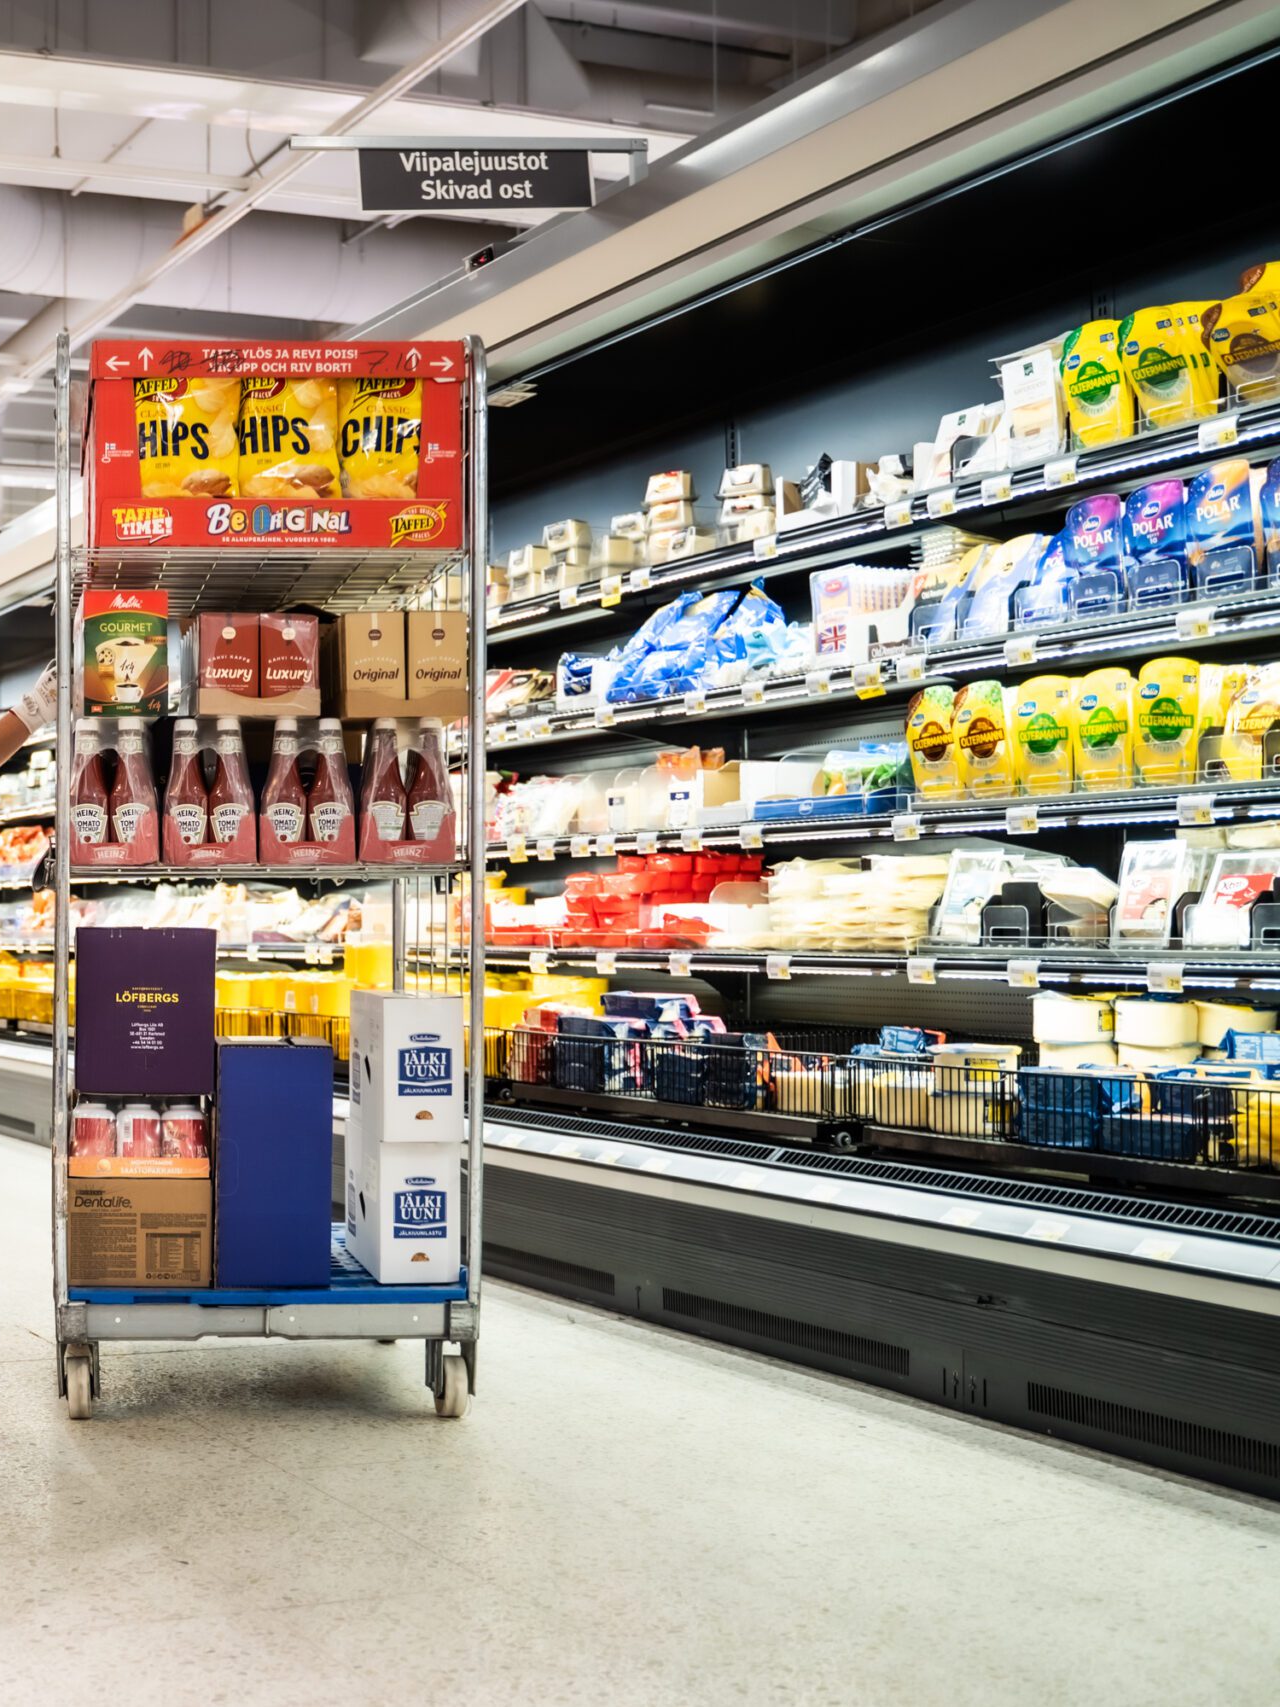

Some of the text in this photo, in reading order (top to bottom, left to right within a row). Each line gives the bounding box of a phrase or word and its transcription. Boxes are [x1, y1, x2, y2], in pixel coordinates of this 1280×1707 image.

[399, 151, 549, 177] Viipalejuustot
[421, 179, 534, 201] Skivad ost
[242, 347, 273, 359] YLÖS
[275, 349, 289, 359] JA
[293, 349, 321, 359] REVI
[325, 349, 358, 359] POIS!
[235, 362, 258, 373] UPP
[261, 362, 287, 373] OCH
[291, 362, 314, 373] RIV
[315, 362, 352, 373] BORT!
[360, 350, 420, 375] 7.10
[1133, 358, 1186, 381] OLTERMANNI
[136, 378, 176, 396] AFFEL
[1070, 373, 1118, 396] OLTERMANNI
[139, 419, 210, 461] HIPS
[239, 415, 311, 456] HIPS
[112, 507, 165, 525] TAFFEL
[1196, 495, 1241, 522] POLAR
[121, 516, 173, 536] TIME!
[206, 502, 248, 535] Be
[391, 517, 433, 534] TAFFEL
[1132, 514, 1174, 537] POLAR
[1074, 529, 1113, 550] POLAR
[99, 622, 152, 633] GOURMET
[205, 666, 252, 682] Luxury
[266, 667, 312, 683] Luxury
[353, 667, 399, 682] Original
[415, 667, 462, 682] Original
[1080, 721, 1126, 736] OLTERMANNI
[1140, 715, 1192, 728] OLTERMANNI
[960, 729, 1004, 747] OLTERMANNI
[1020, 728, 1067, 741] OLTERMANNI
[77, 809, 98, 818] HEINZ
[274, 808, 295, 817] HEINZ
[97, 850, 125, 859] HEINZ
[293, 848, 321, 857] HEINZ
[393, 848, 422, 857] HEINZ
[115, 990, 180, 1003] LÖFBERGS
[404, 1050, 446, 1066] JÄLKI
[405, 1065, 445, 1077] UUNI
[74, 1195, 131, 1209] Dentalife
[400, 1192, 442, 1208] JÄLKI
[401, 1207, 441, 1220] UUNI
